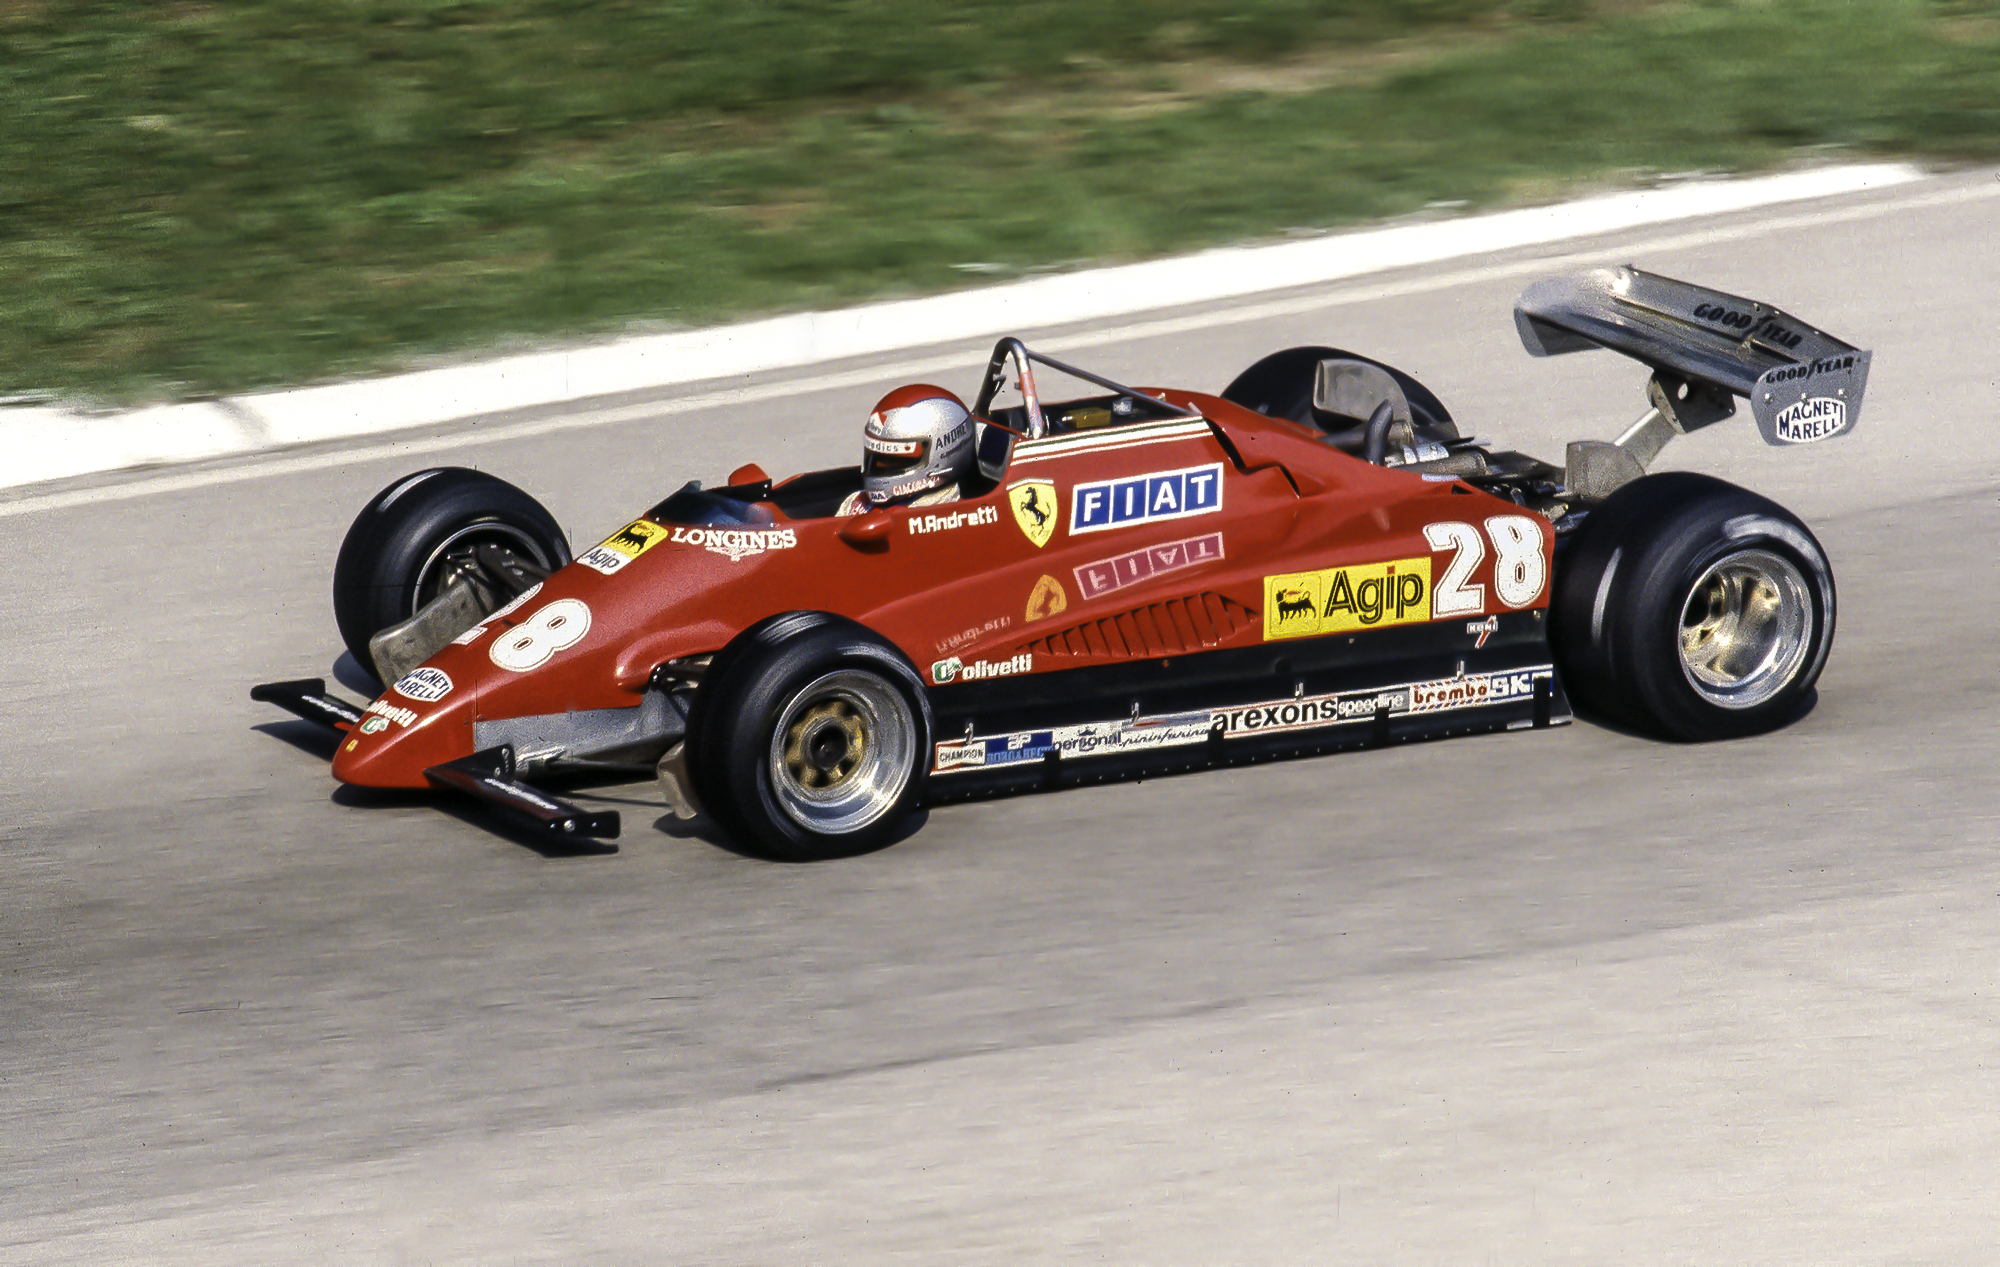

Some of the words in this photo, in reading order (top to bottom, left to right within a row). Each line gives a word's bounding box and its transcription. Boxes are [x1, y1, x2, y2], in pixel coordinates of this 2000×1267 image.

[1779, 401, 1843, 428] MAGNETI
[1779, 414, 1843, 440] MARELLI
[1083, 473, 1215, 525] FIAT
[909, 505, 998, 535] M.Andretti
[670, 527, 797, 550] LONGINES
[581, 547, 620, 570] Agip
[1422, 514, 1547, 620] 28
[1323, 565, 1424, 625] Agip
[962, 653, 1032, 681] olivetti
[1413, 682, 1488, 705] brembo
[1491, 671, 1552, 696] SK
[1211, 697, 1338, 732] arexons
[1052, 730, 1122, 752] personal
[939, 748, 985, 762] CHAMPION
